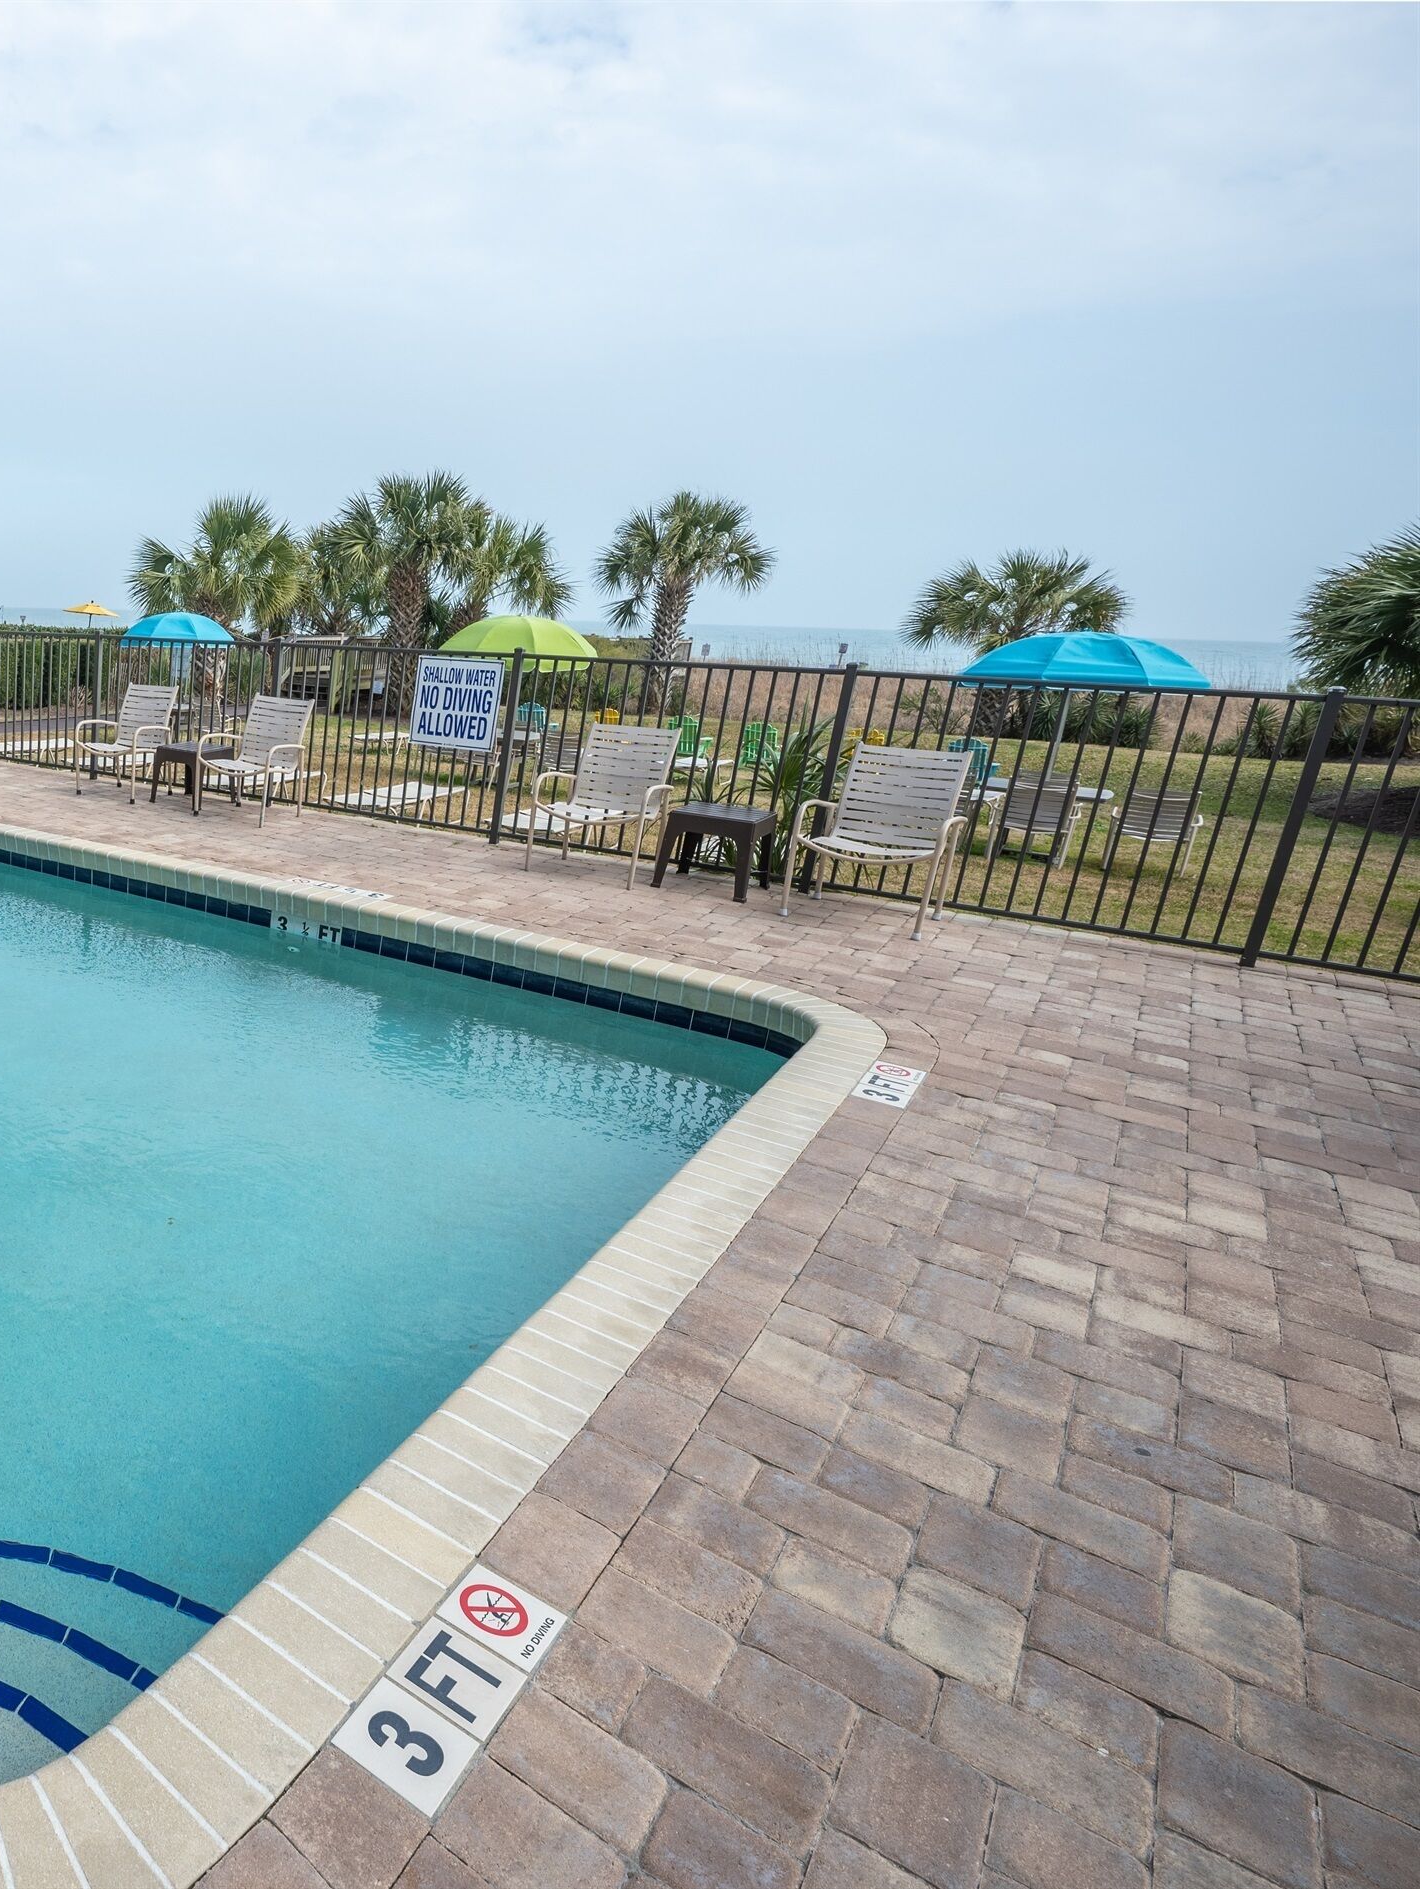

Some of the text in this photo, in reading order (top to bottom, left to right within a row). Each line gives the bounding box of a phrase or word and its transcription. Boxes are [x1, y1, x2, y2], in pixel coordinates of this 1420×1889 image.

[423, 665, 496, 687] SHALLOW WATER
[420, 684, 493, 714] NO DIVING
[417, 711, 488, 741] ALLOWED
[277, 916, 288, 931] 3
[318, 924, 341, 943] FT
[862, 1074, 909, 1102] 3 FT
[520, 1617, 555, 1659] NO DIVING
[367, 1629, 502, 1777] 3 FT
